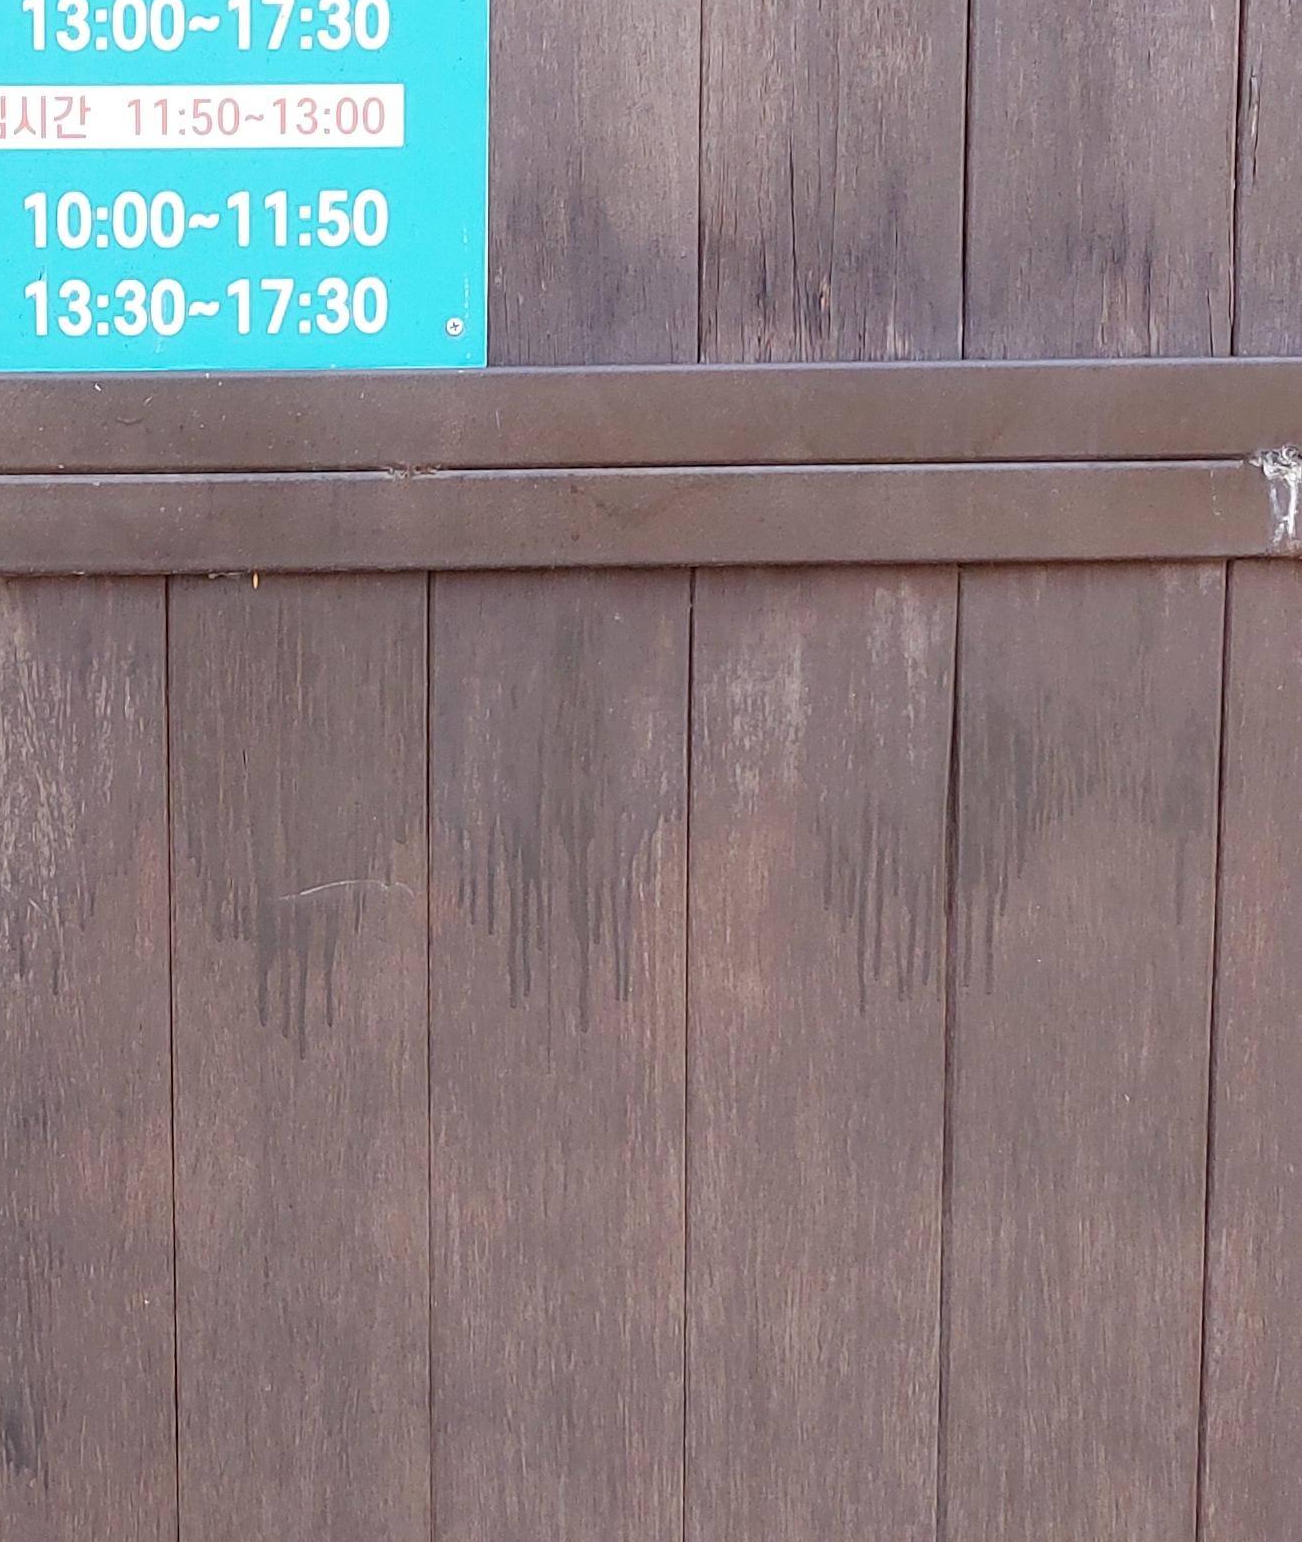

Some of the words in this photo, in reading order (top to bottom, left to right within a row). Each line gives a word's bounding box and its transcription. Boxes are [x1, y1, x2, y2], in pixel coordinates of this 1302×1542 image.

[126, 96, 387, 137] 11:50~13:00
[24, 189, 389, 250] 10:00~11:50
[24, 277, 389, 339] 13:30~17:30
